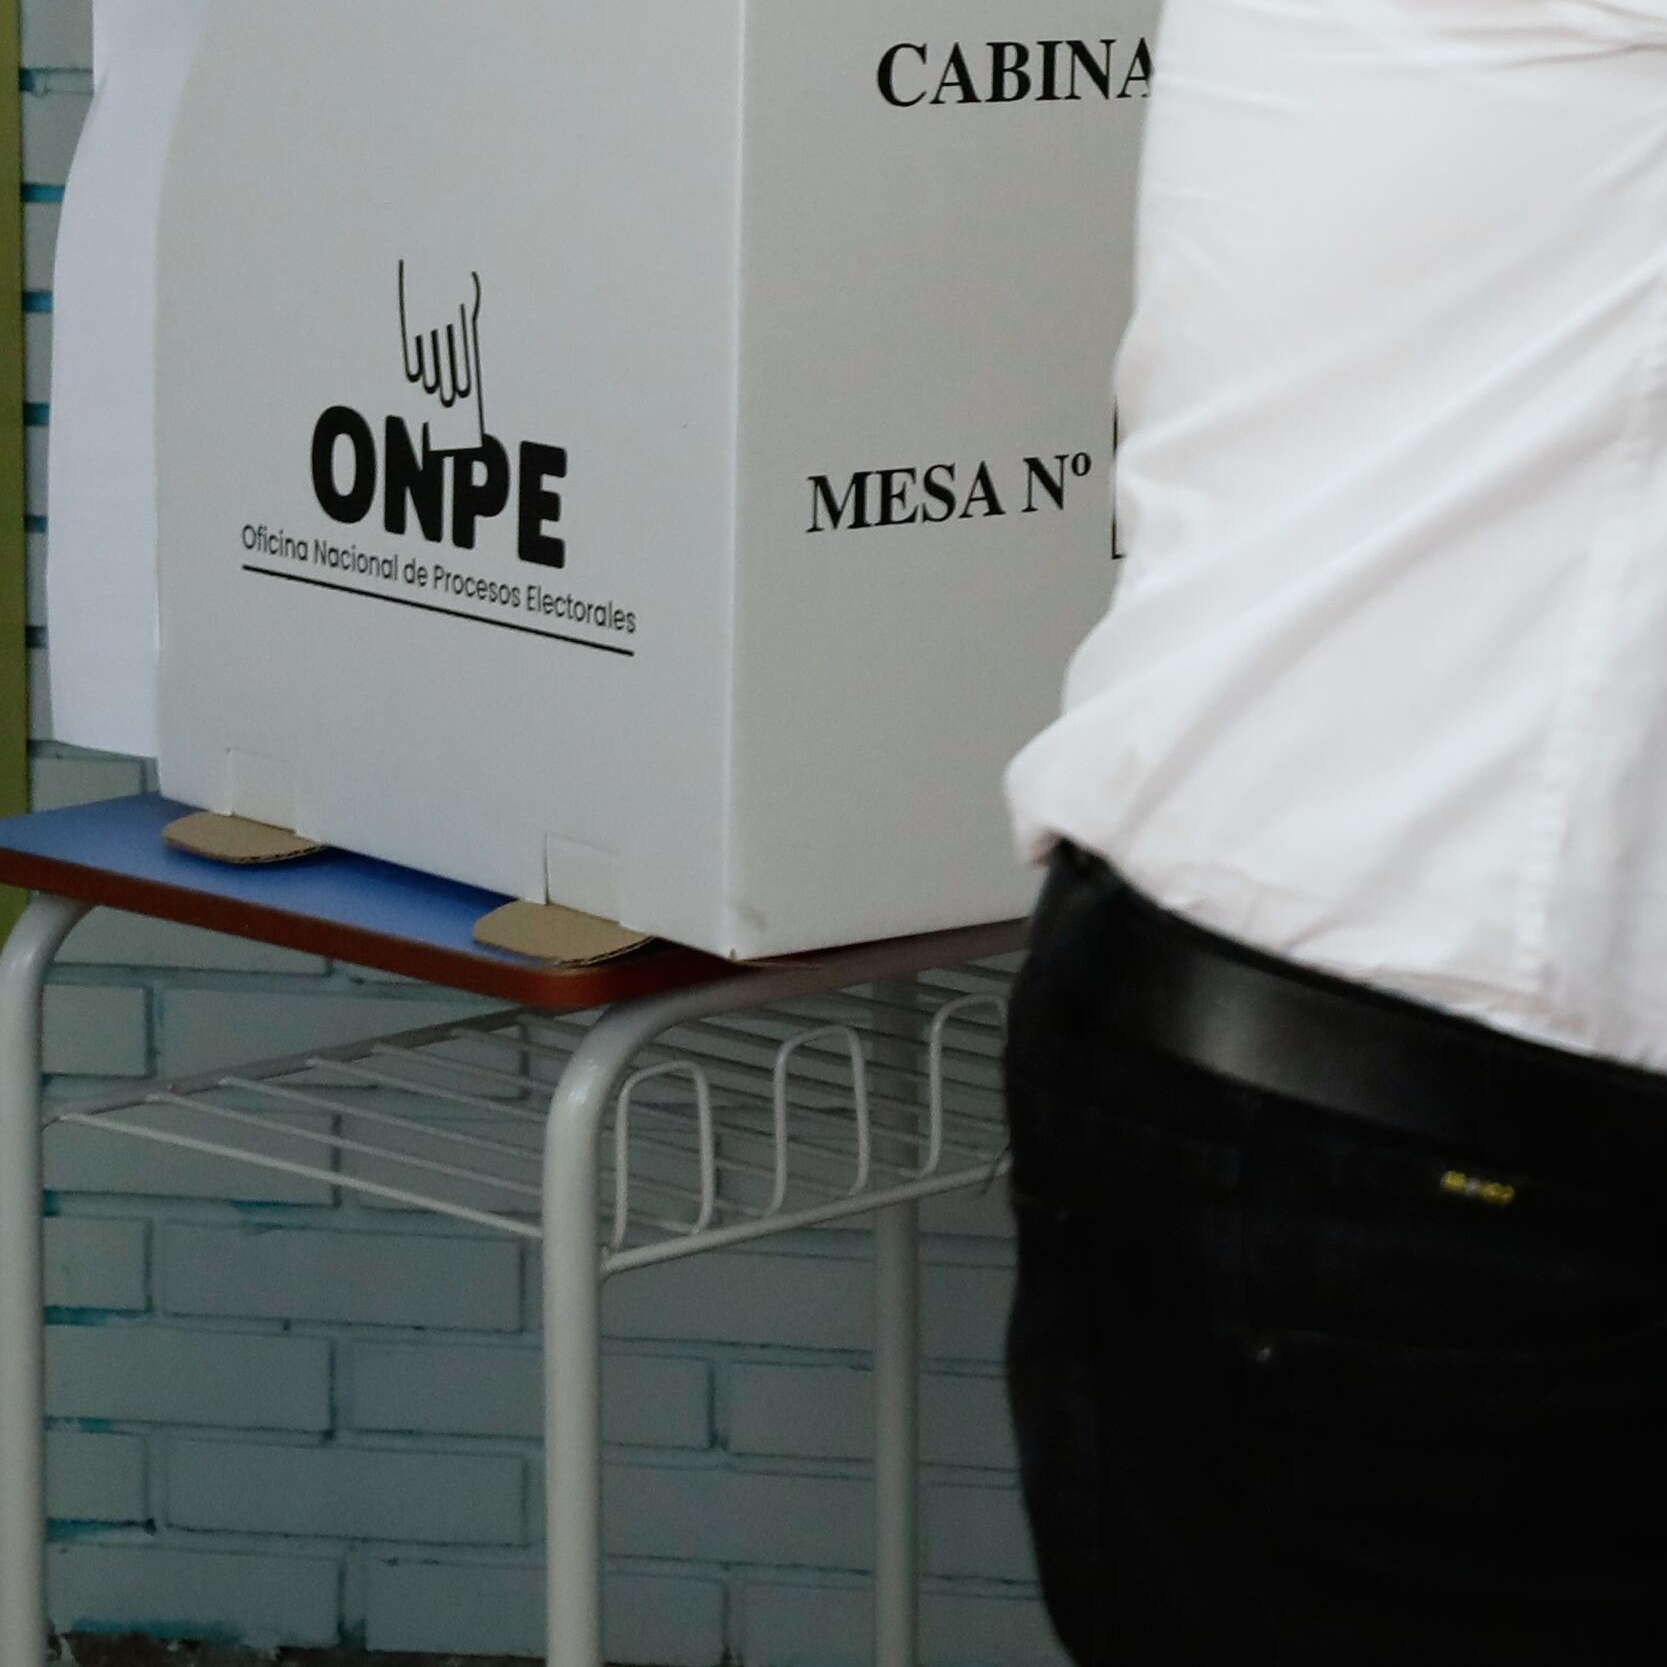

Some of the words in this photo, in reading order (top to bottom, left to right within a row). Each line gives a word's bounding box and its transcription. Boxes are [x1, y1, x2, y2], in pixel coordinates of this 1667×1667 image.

[876, 37, 1154, 108] CABINA
[311, 404, 568, 569] ONPE
[805, 460, 1006, 533] MESA
[1021, 452, 1092, 514] Nº
[241, 523, 308, 562] Oficina
[314, 538, 399, 581] Nacional
[403, 555, 429, 587] de
[434, 564, 521, 609] Procesos
[526, 584, 637, 634] Electorales
